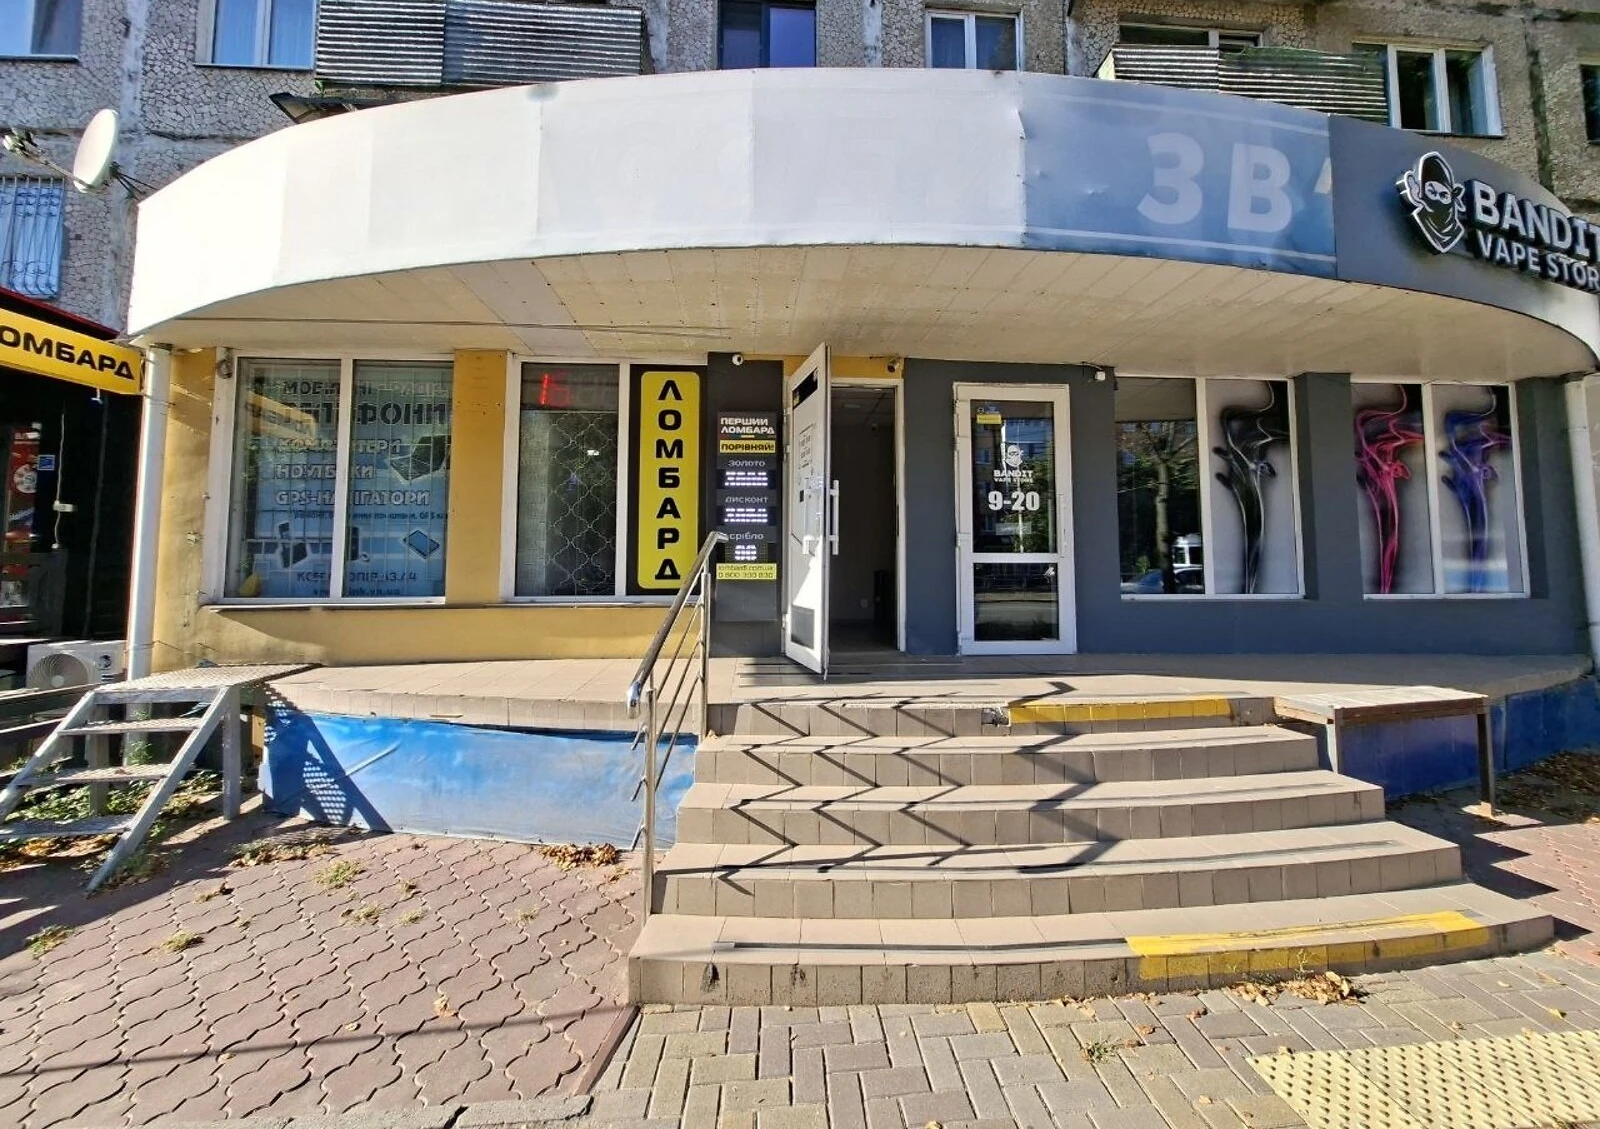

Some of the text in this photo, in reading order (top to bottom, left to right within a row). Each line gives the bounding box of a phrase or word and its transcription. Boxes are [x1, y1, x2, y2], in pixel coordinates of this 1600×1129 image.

[1471, 180, 1600, 262] BANDIT
[1475, 230, 1541, 272] VAPE
[0, 324, 135, 380] ОМБАРД
[720, 426, 775, 434] ЛОМБАРД
[275, 463, 374, 480] НОУТБКИ
[654, 379, 683, 580] ЛОМБАРД
[993, 469, 1034, 477] BANDIT
[274, 490, 430, 506] GPS-НАІГАТОРИ
[988, 490, 1041, 511] 9-20
[729, 531, 764, 541] срібло
